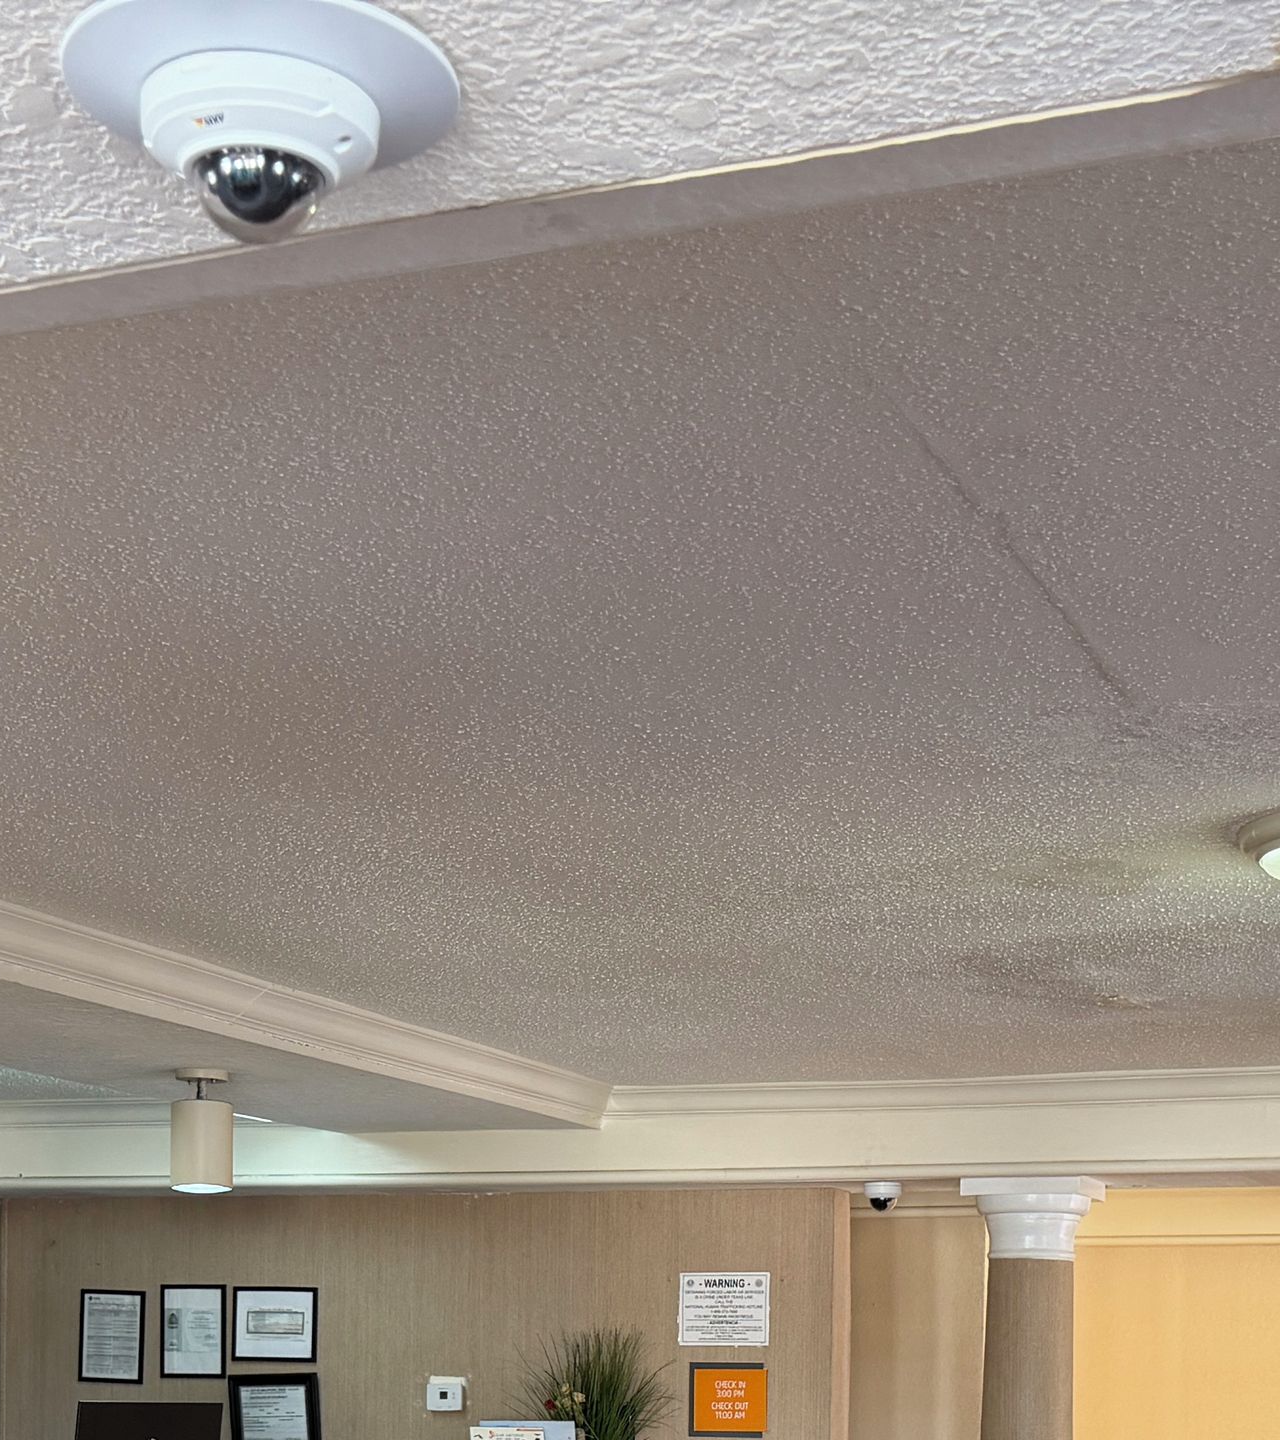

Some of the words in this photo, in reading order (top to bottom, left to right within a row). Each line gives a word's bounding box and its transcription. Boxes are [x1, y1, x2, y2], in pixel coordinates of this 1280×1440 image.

[704, 1279, 745, 1288] WARNING
[714, 1380, 737, 1389] CHECK
[738, 1380, 746, 1389] IN
[716, 1389, 732, 1398] 3:00
[733, 1389, 745, 1398] PM
[711, 1402, 734, 1410] CHECK
[734, 1402, 749, 1410] OUT
[734, 1411, 745, 1419] AM
